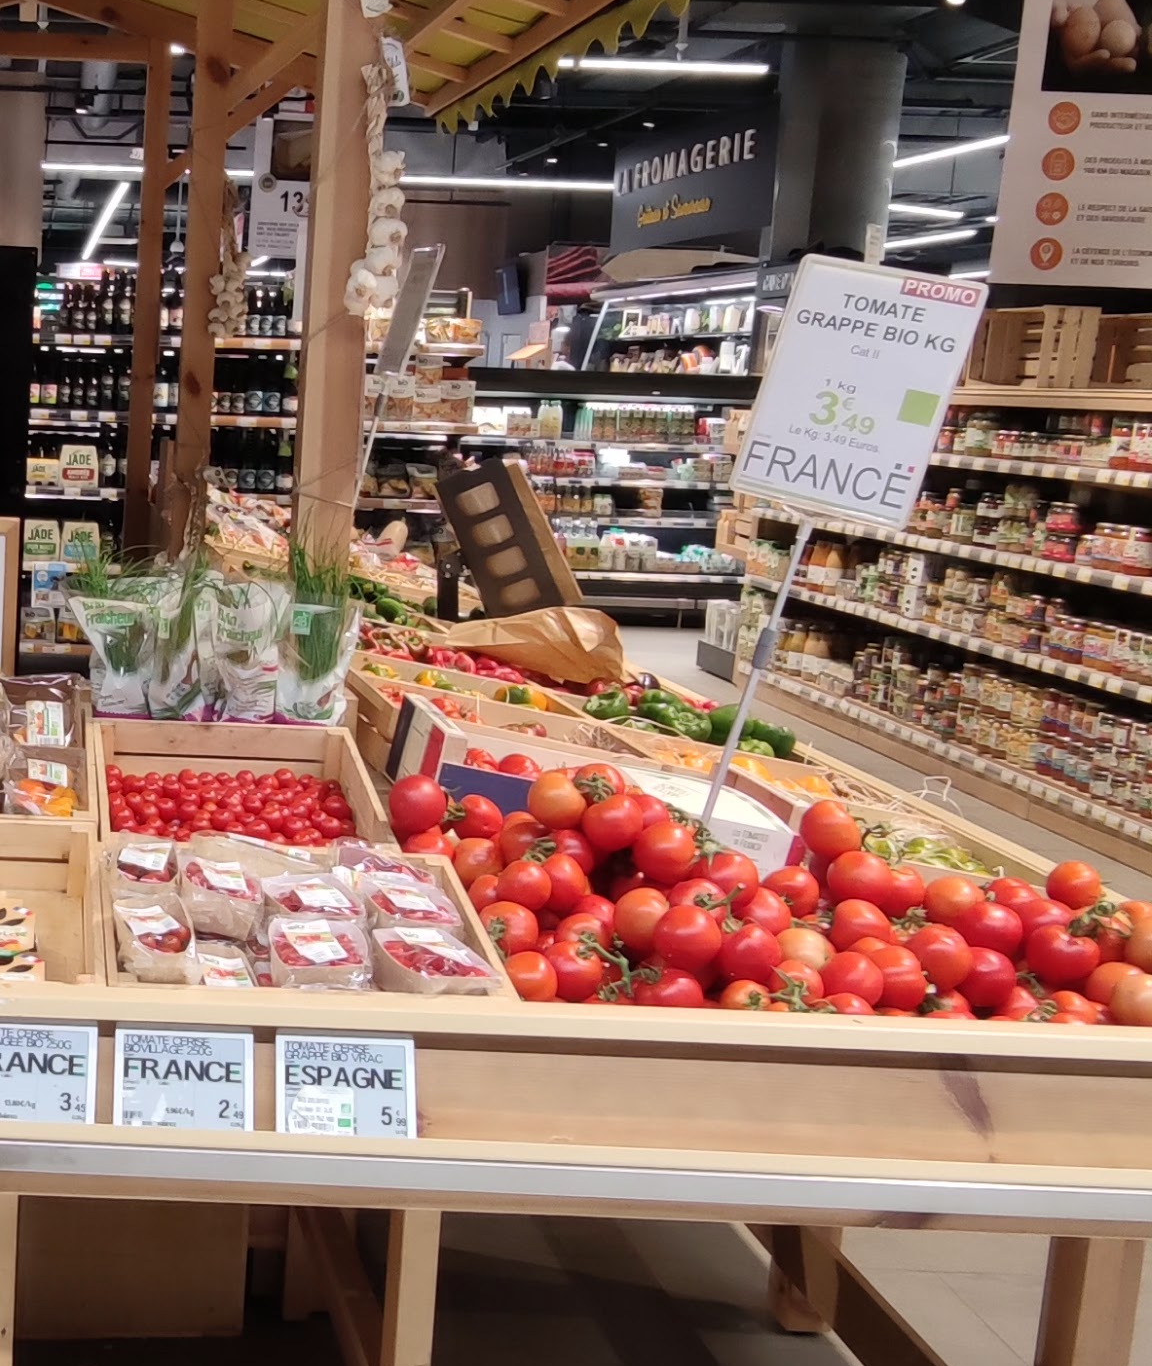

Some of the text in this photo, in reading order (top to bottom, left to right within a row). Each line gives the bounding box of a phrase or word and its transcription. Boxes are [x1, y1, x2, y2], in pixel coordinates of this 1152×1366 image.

[633, 129, 757, 190] FROMAGERIE
[902, 280, 977, 305] PROMO
[843, 293, 927, 323] TOMATE
[797, 309, 956, 354] GRAPPE BIO KG
[850, 344, 870, 358] Cat
[837, 379, 857, 394] kg
[808, 391, 840, 426] 3
[788, 423, 802, 435] Le
[66, 454, 92, 466] JADE
[742, 439, 913, 510] FRANCE
[28, 528, 54, 541] JADE
[16, 1028, 54, 1040] CERISE
[124, 1034, 210, 1046] TOMATE CERISE
[26, 1037, 44, 1048] BIO
[46, 1039, 72, 1050] 250G
[186, 1045, 213, 1057] 250G
[285, 1042, 371, 1054] TOMATE CERISE
[285, 1051, 384, 1064] GRAPPE BIO VRAC
[123, 1057, 243, 1084] FRANCE
[285, 1064, 404, 1091] ESPAGNE
[59, 1092, 86, 1113] 3 45
[218, 1099, 244, 1119] 2 49
[380, 1106, 407, 1127] 5 99
